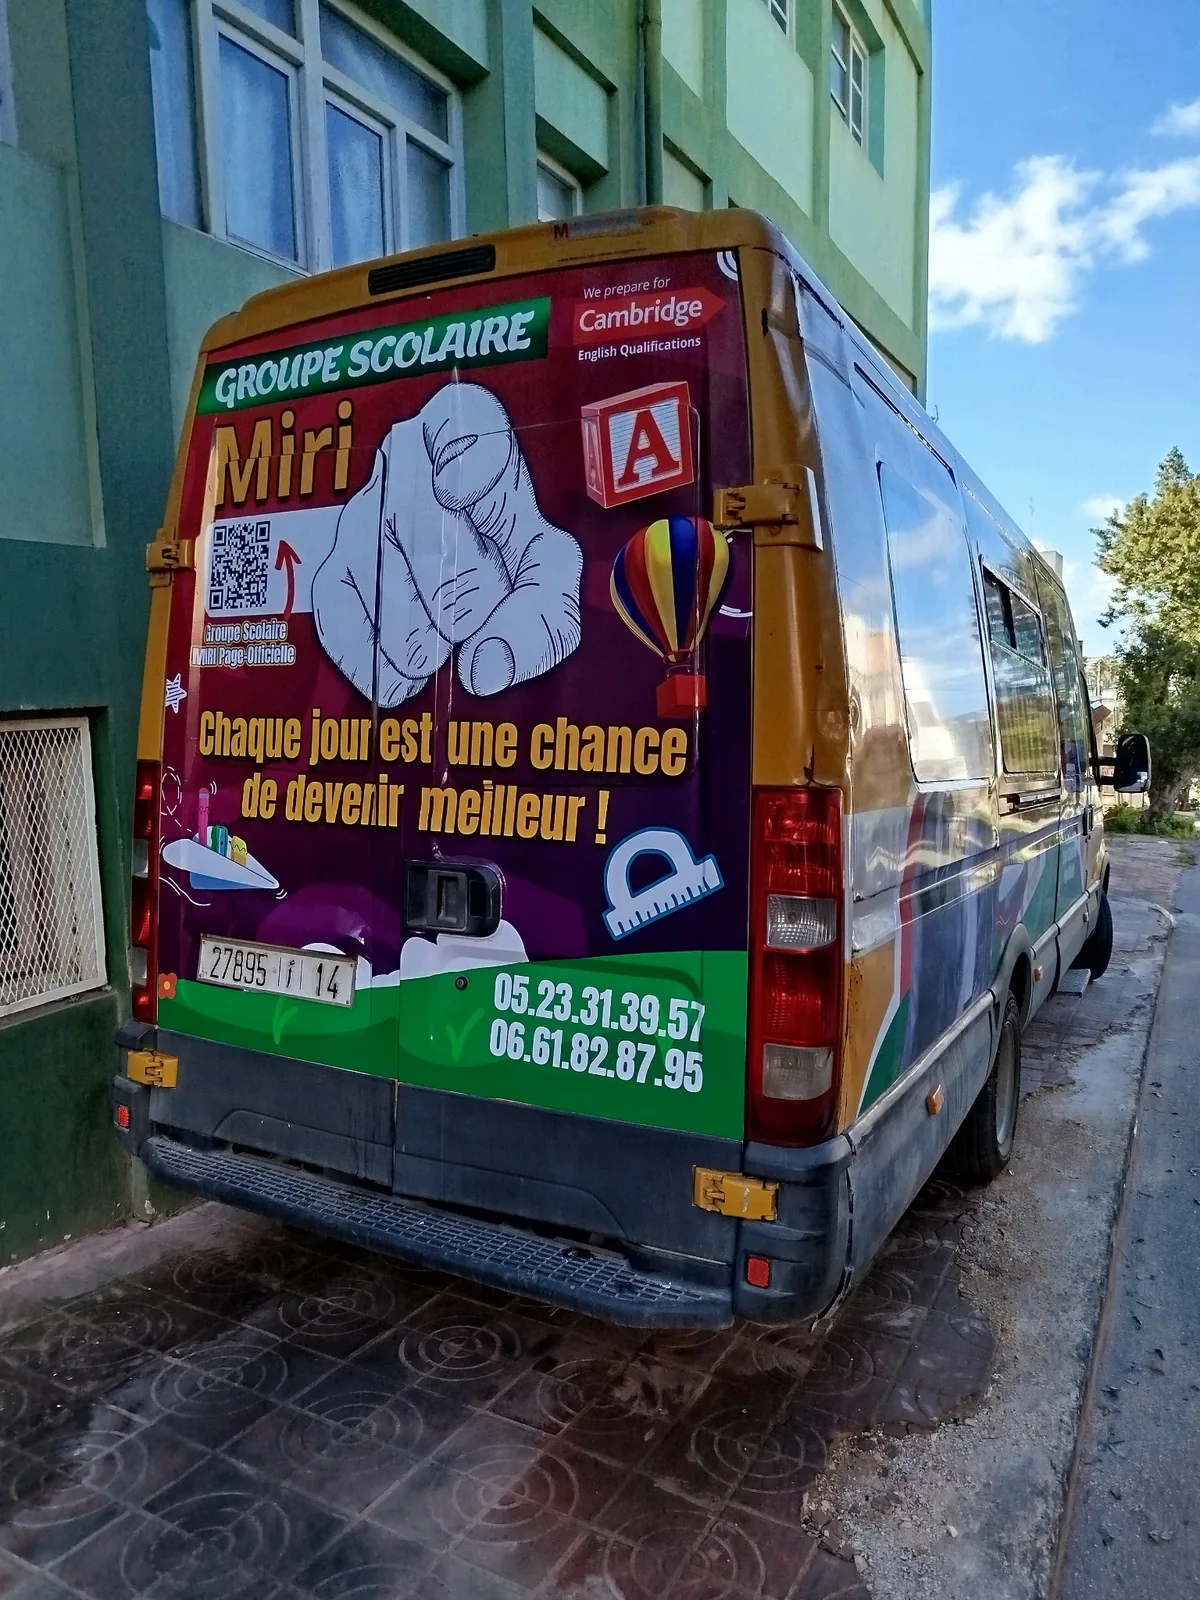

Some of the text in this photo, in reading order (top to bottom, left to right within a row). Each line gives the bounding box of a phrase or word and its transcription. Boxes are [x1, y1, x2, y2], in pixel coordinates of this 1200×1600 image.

[578, 296, 703, 332] Cambridge
[583, 276, 671, 300] We prepare for
[215, 310, 535, 409] GROUPE SCOLAIRE
[578, 336, 702, 362] English Qualifications
[214, 400, 353, 506] Miri
[617, 409, 681, 486] A
[206, 619, 287, 643] Groupe Scolaire
[219, 645, 295, 667] Page-Officielle
[199, 708, 688, 776] Chaque jour est une chance
[241, 772, 278, 819] de
[285, 773, 404, 827] devenir
[418, 779, 586, 842] meilleur
[209, 946, 268, 987] 27895
[315, 962, 341, 999] 14
[494, 972, 706, 1042] 05.23.31.39.57
[489, 1018, 704, 1093] 06.61.82.87.95
